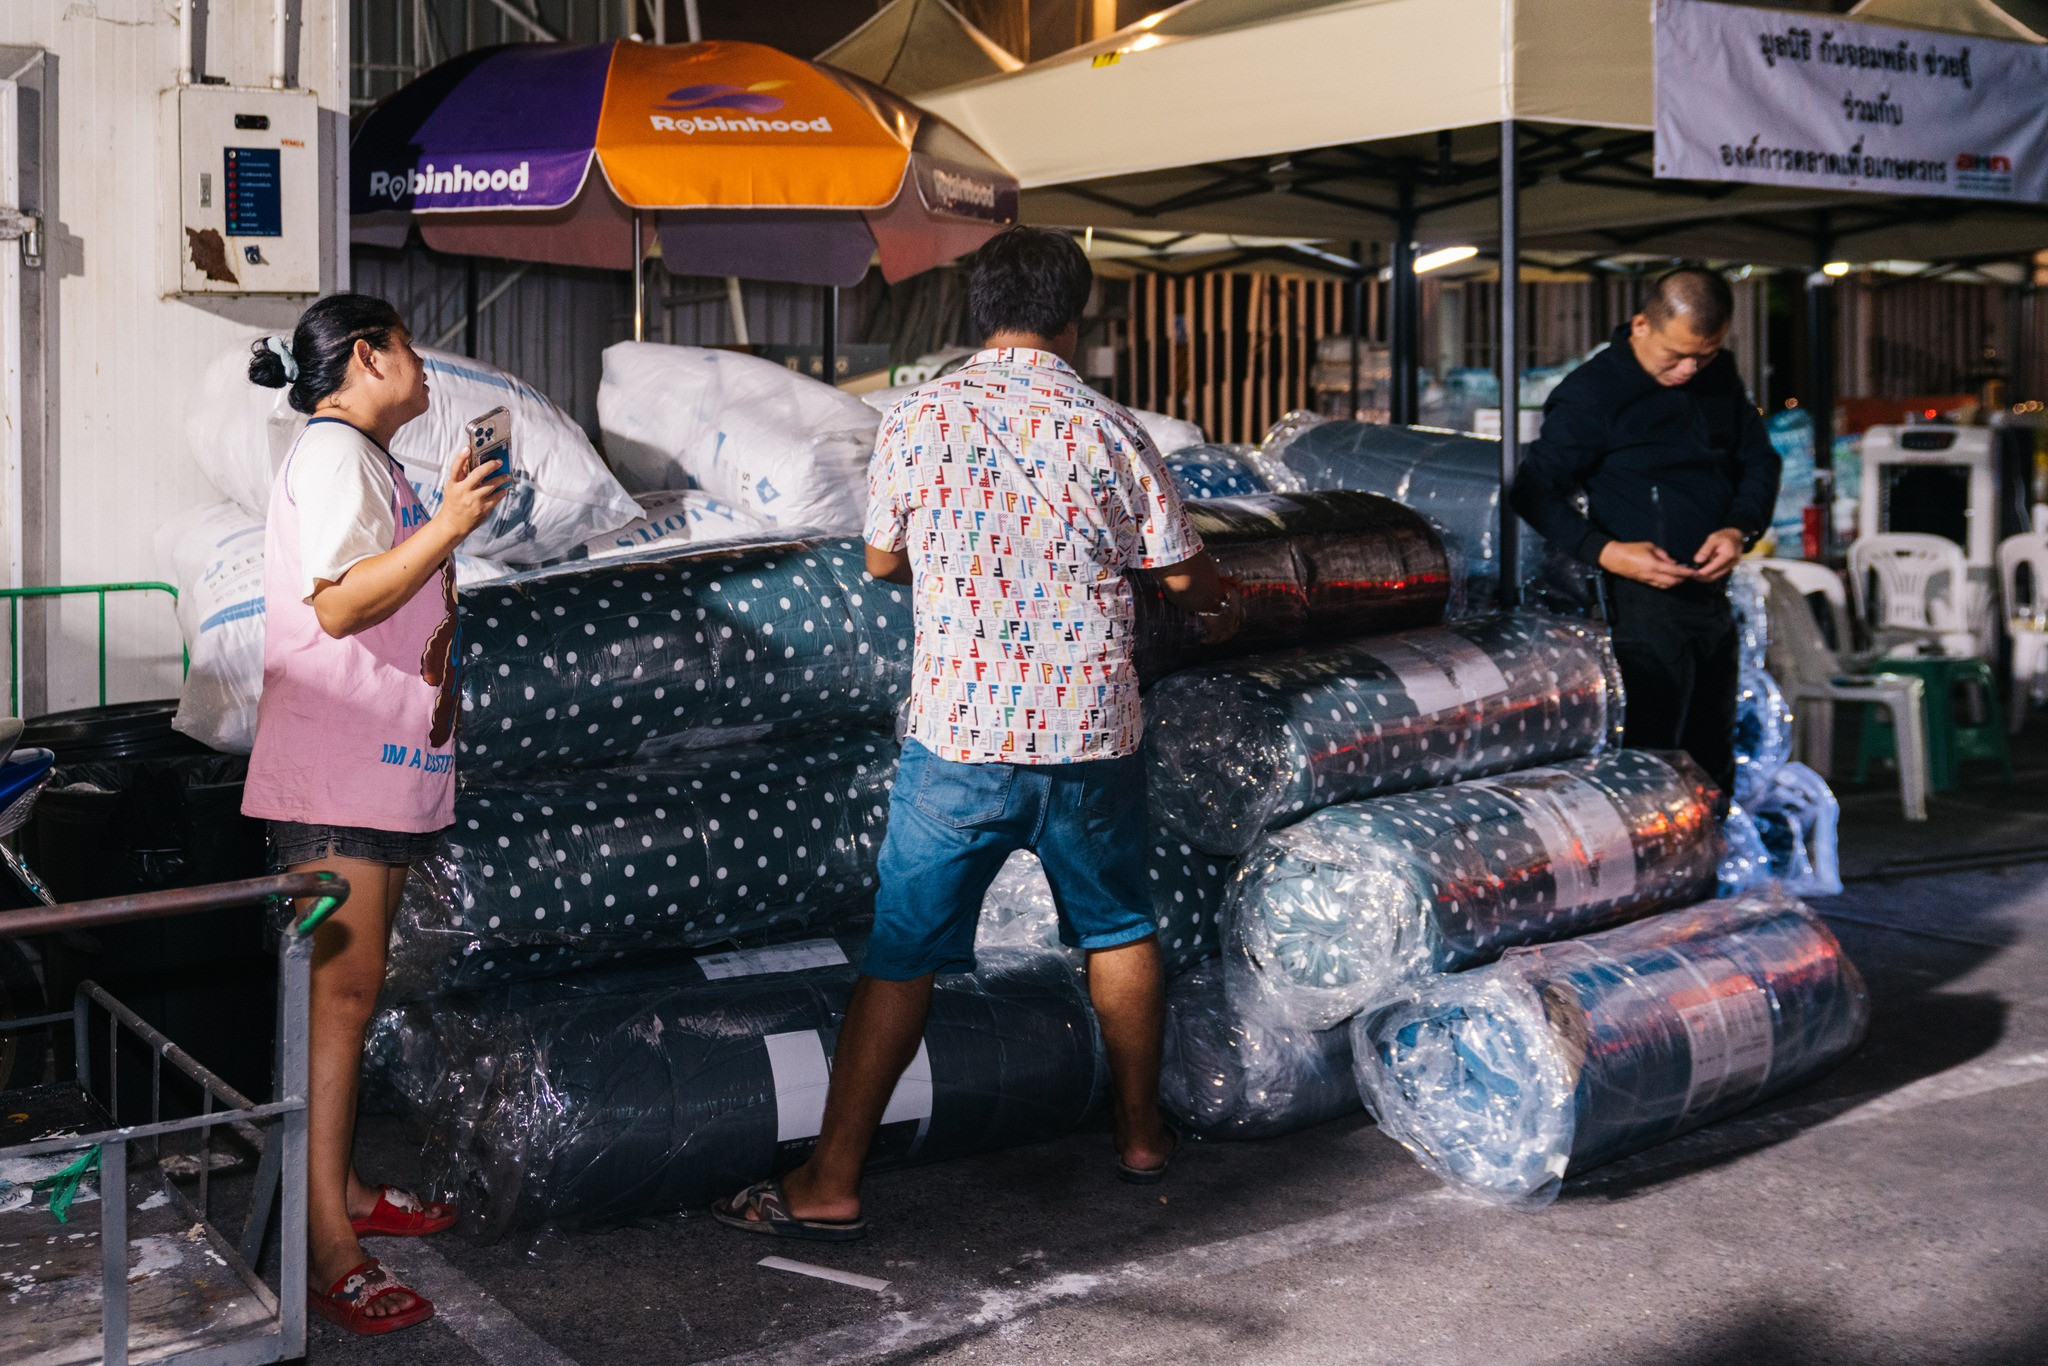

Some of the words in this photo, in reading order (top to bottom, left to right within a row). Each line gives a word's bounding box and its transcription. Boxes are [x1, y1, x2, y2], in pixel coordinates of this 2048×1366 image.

[650, 115, 832, 135] Robinhood
[369, 162, 529, 202] Robinhood
[381, 744, 407, 766] IM
[409, 748, 421, 769] A
